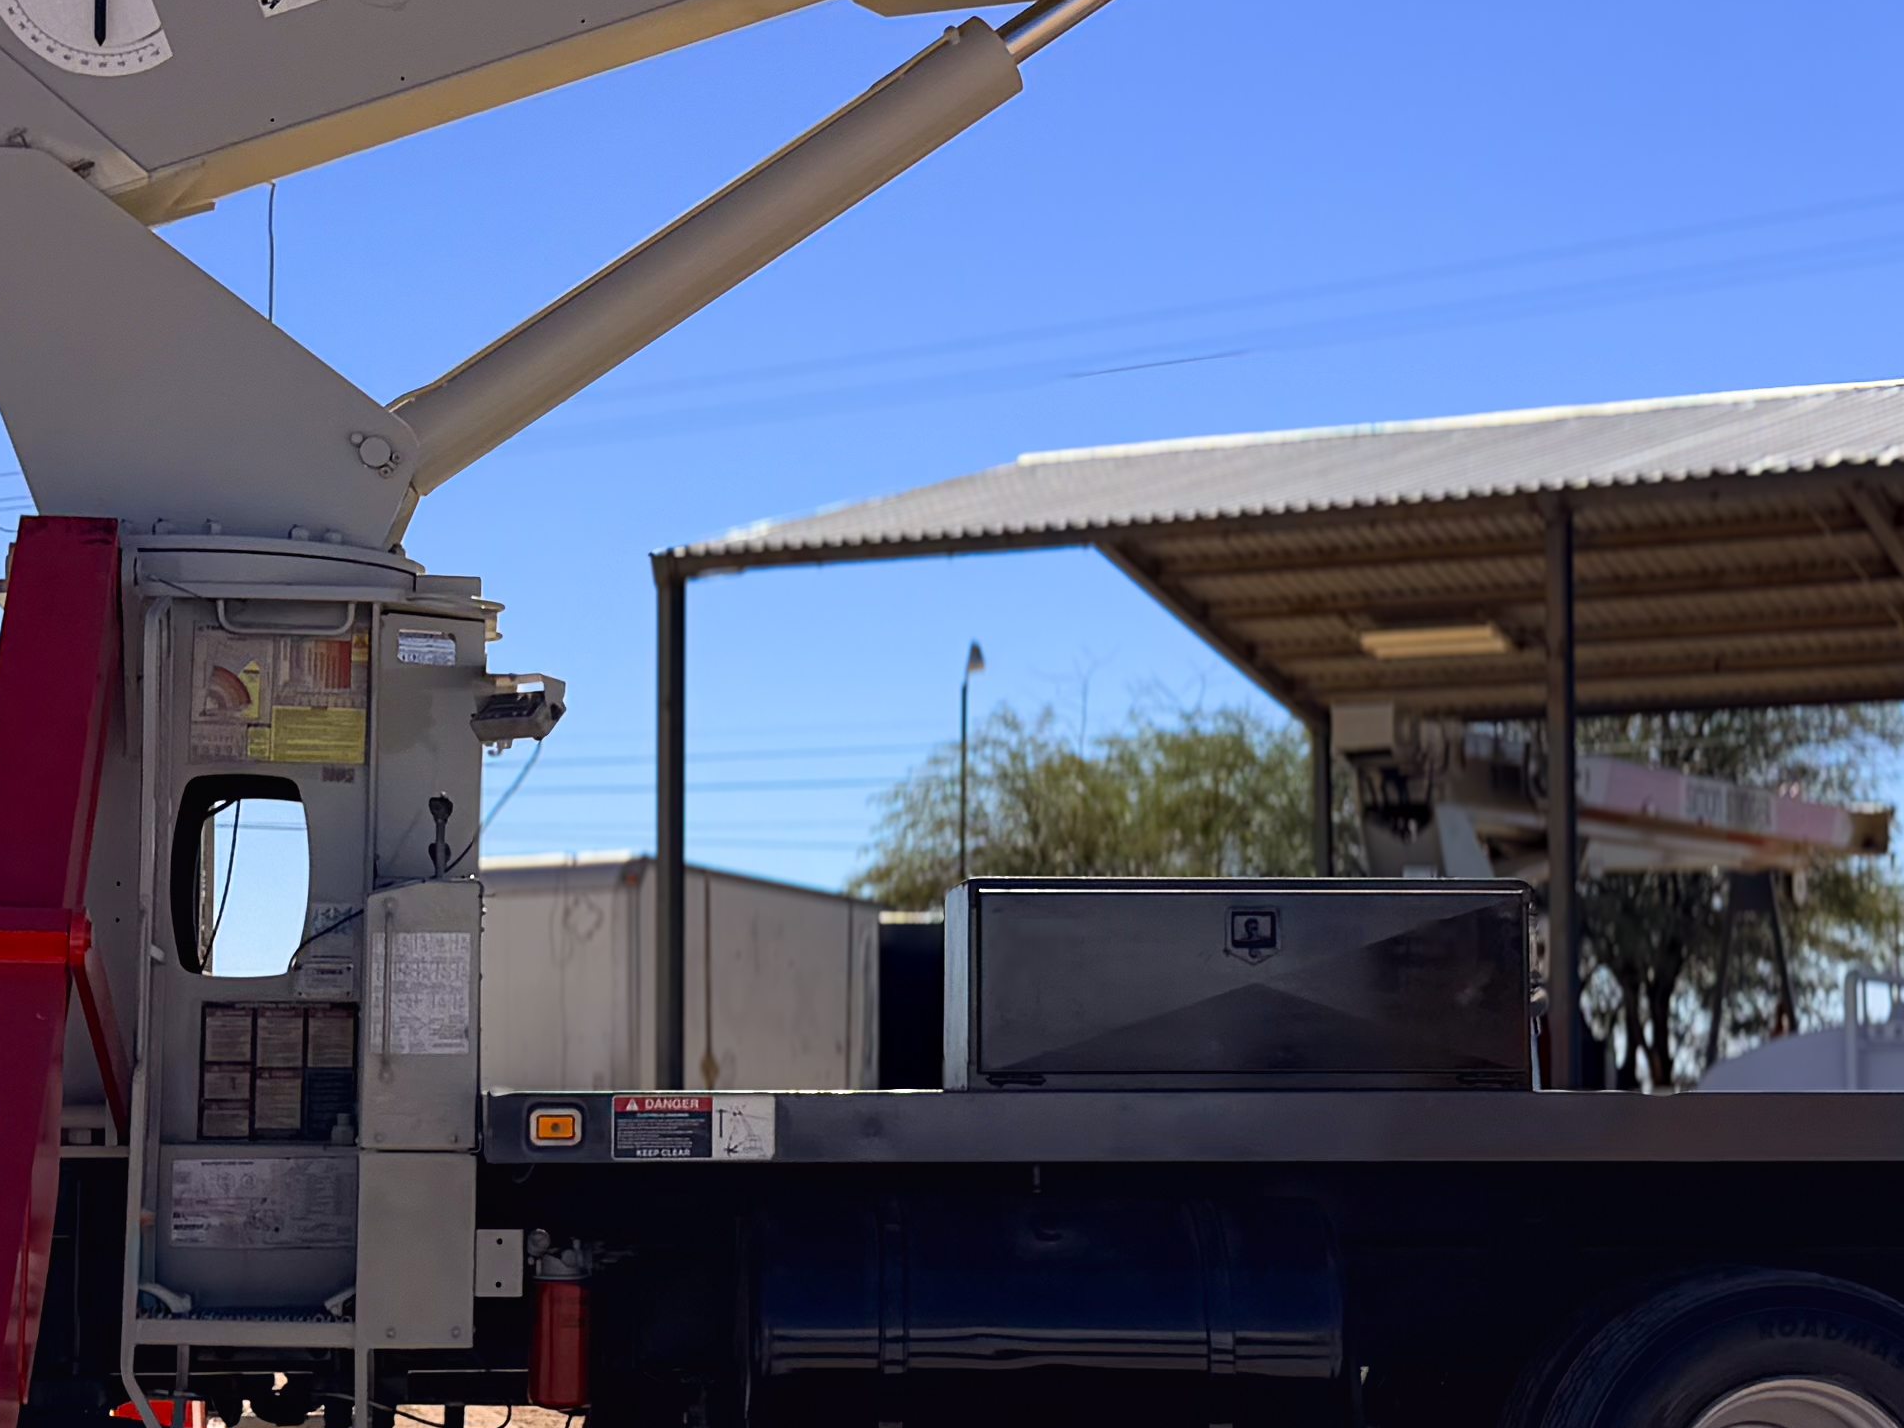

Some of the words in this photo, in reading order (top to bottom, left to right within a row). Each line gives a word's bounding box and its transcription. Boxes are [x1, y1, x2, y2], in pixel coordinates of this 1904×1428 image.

[645, 1098, 700, 1110] DANGER
[636, 1149, 659, 1157] KEEP
[660, 1149, 691, 1157] CLEAR
